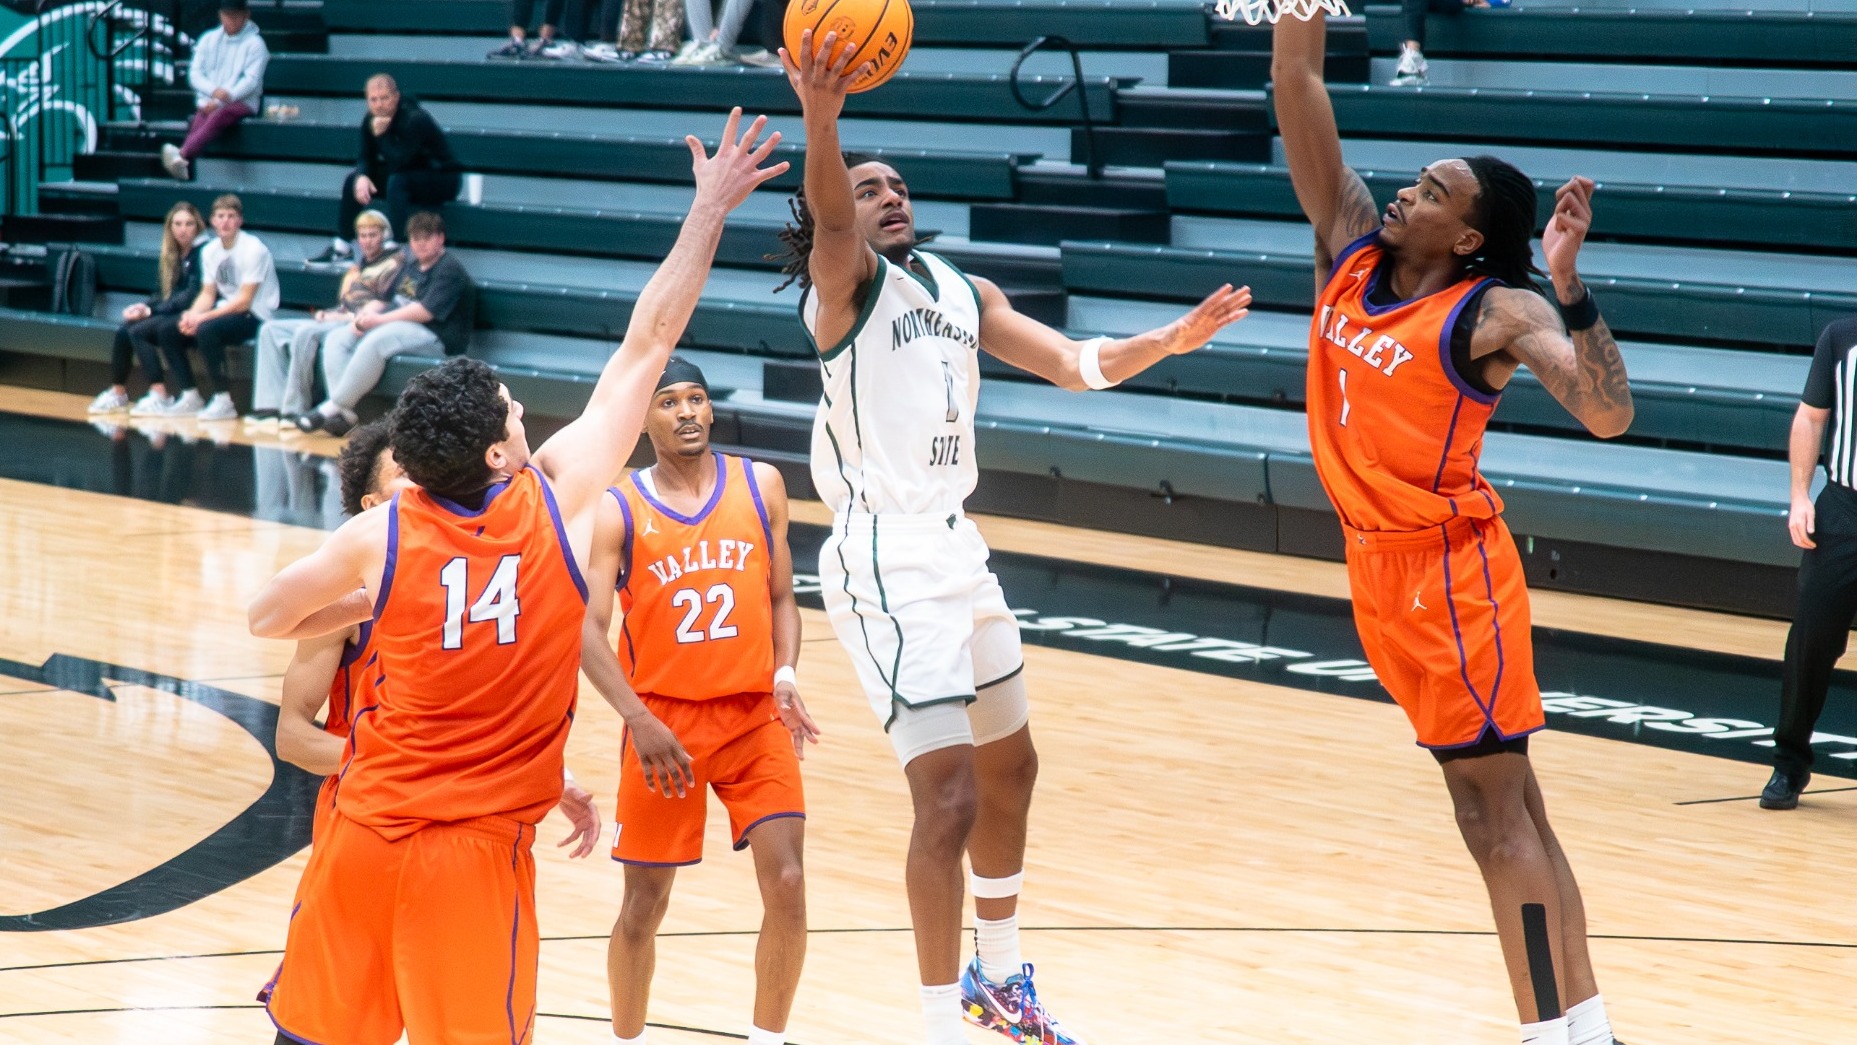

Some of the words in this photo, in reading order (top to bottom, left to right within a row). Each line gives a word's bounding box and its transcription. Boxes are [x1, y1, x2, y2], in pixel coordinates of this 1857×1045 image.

[929, 435, 960, 466] STTE
[647, 539, 755, 586] VALLEY
[440, 552, 522, 650] 14
[671, 582, 739, 645] 22
[1018, 616, 1315, 663] STATE
